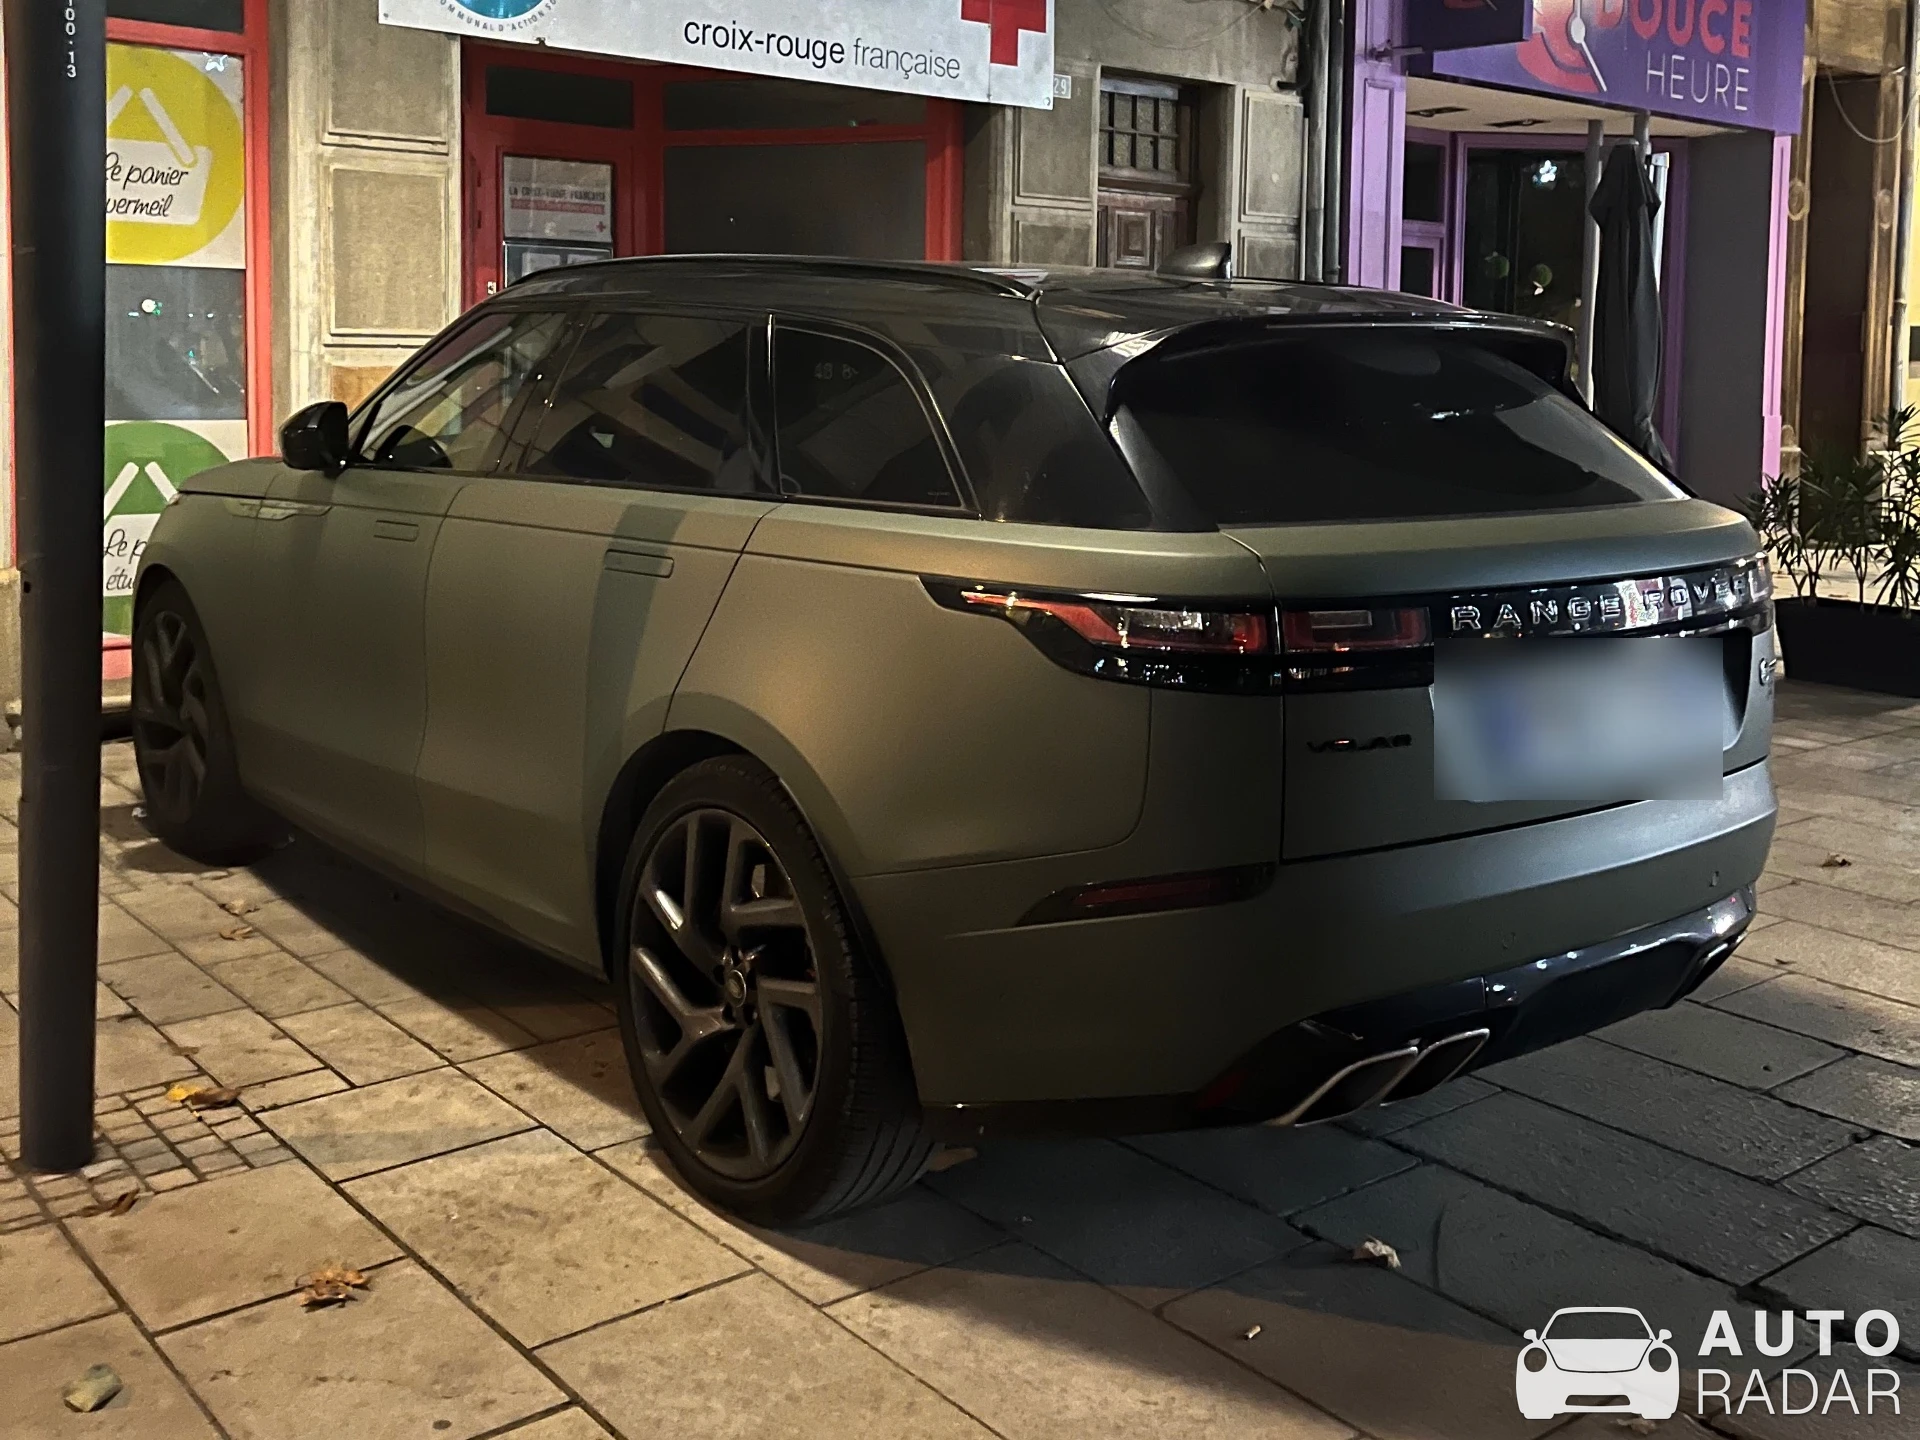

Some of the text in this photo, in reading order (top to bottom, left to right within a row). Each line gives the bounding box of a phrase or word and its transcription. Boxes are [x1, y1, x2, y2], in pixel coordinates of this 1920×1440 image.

[684, 20, 961, 80] croix-rouge française
[1646, 50, 1750, 111] HEURE
[122, 164, 189, 190] panier
[106, 194, 173, 217] vermeil
[105, 528, 128, 558] Le
[1451, 575, 1748, 631] RANGE ROVER
